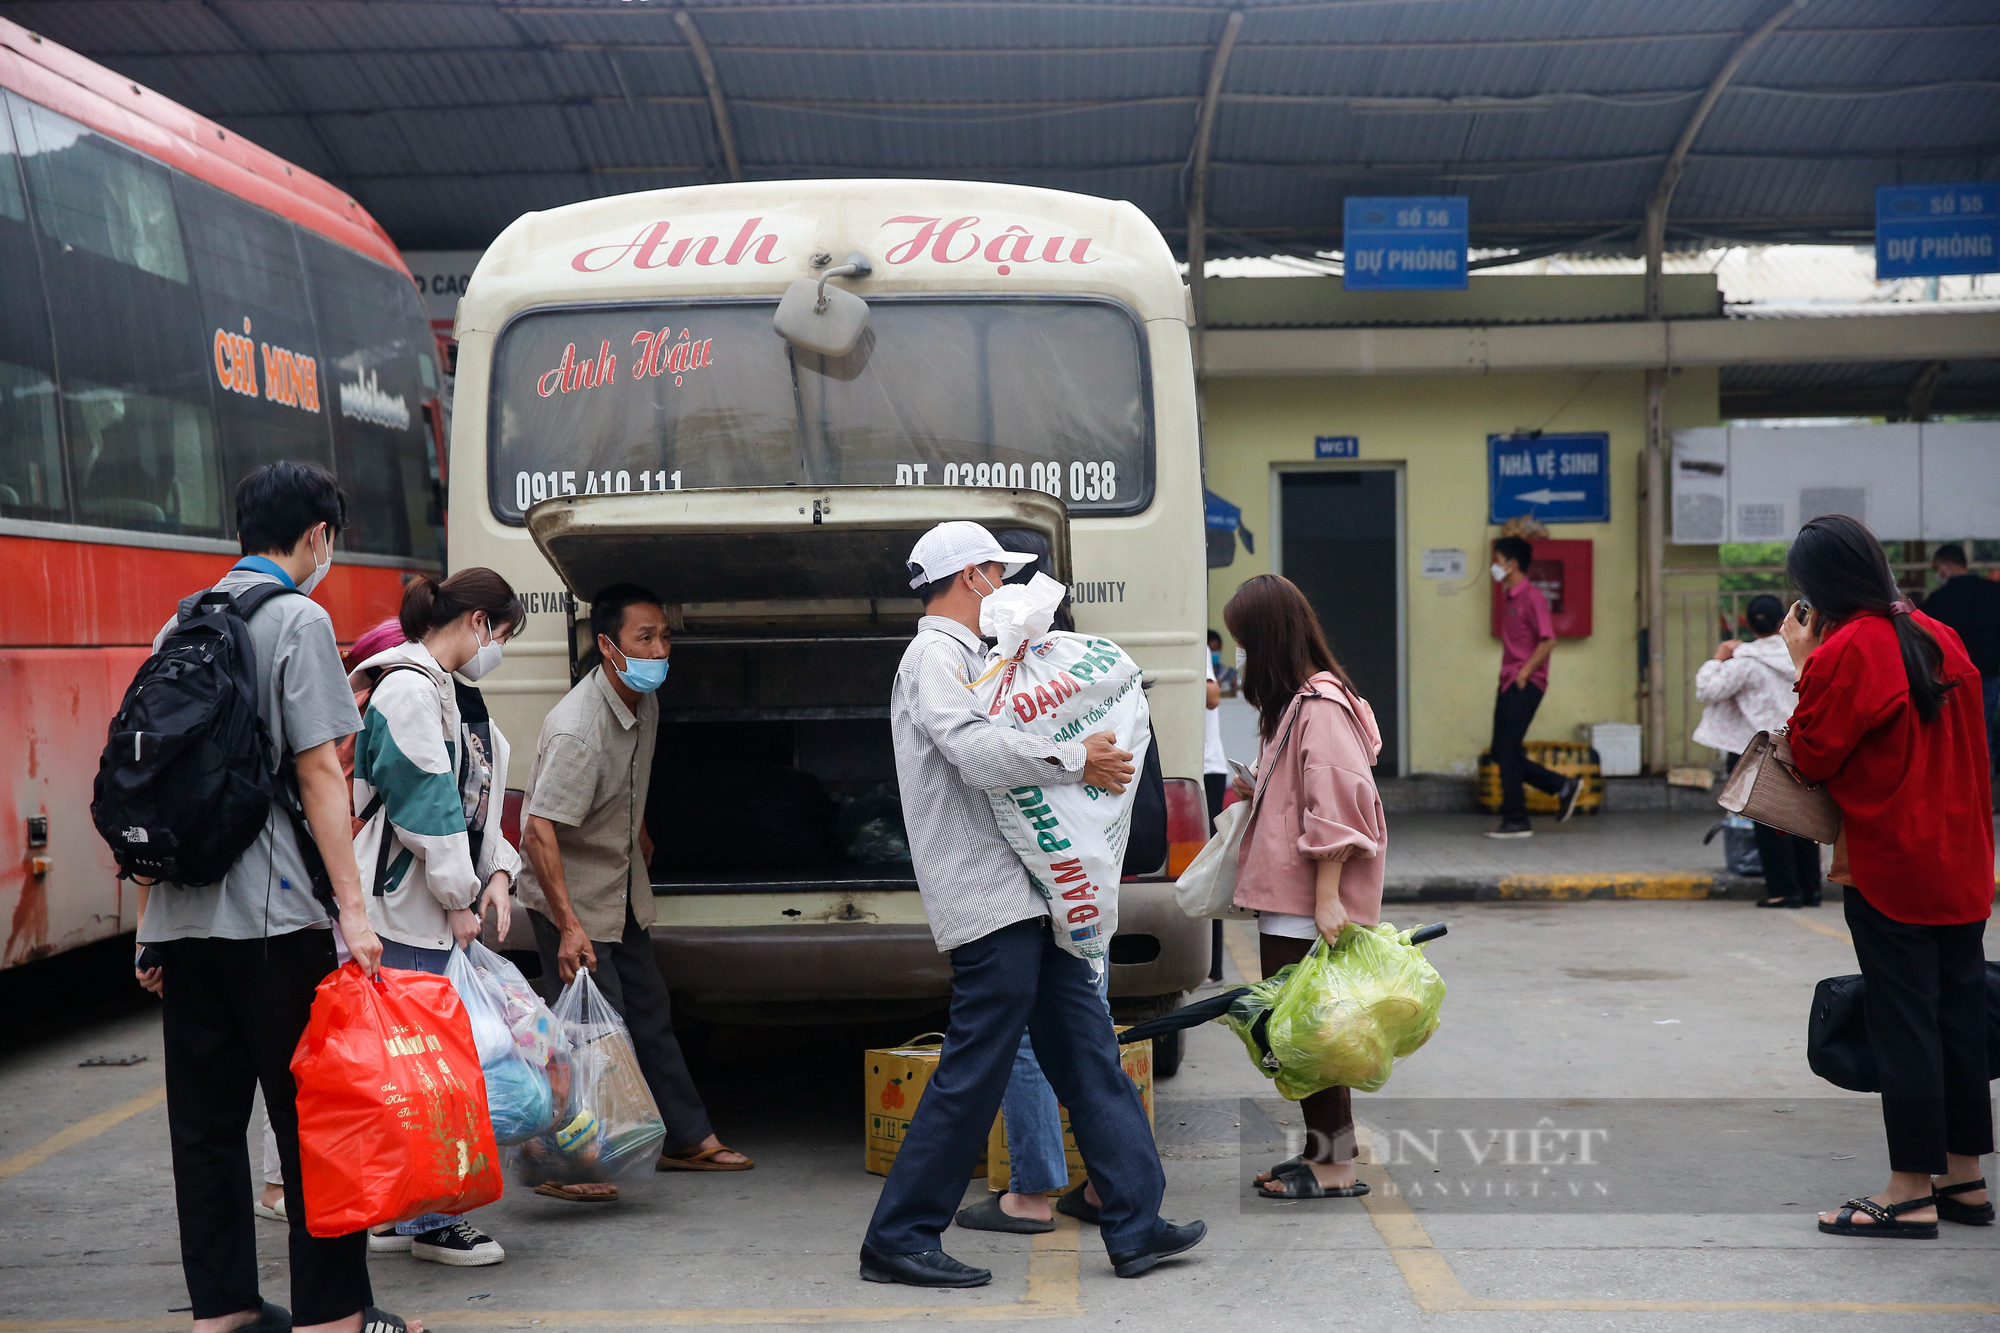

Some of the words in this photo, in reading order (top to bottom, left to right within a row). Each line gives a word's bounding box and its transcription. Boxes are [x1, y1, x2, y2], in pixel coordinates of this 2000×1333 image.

[571, 217, 787, 273] Anh
[880, 216, 1101, 276] Hậu
[261, 341, 320, 413] MINH
[537, 339, 617, 398] Anh
[631, 326, 714, 387] Hậu
[1069, 461, 1117, 501] 038
[1560, 452, 1600, 476] SINH
[516, 470, 577, 511] 0915
[1069, 581, 1126, 604] COUNTY
